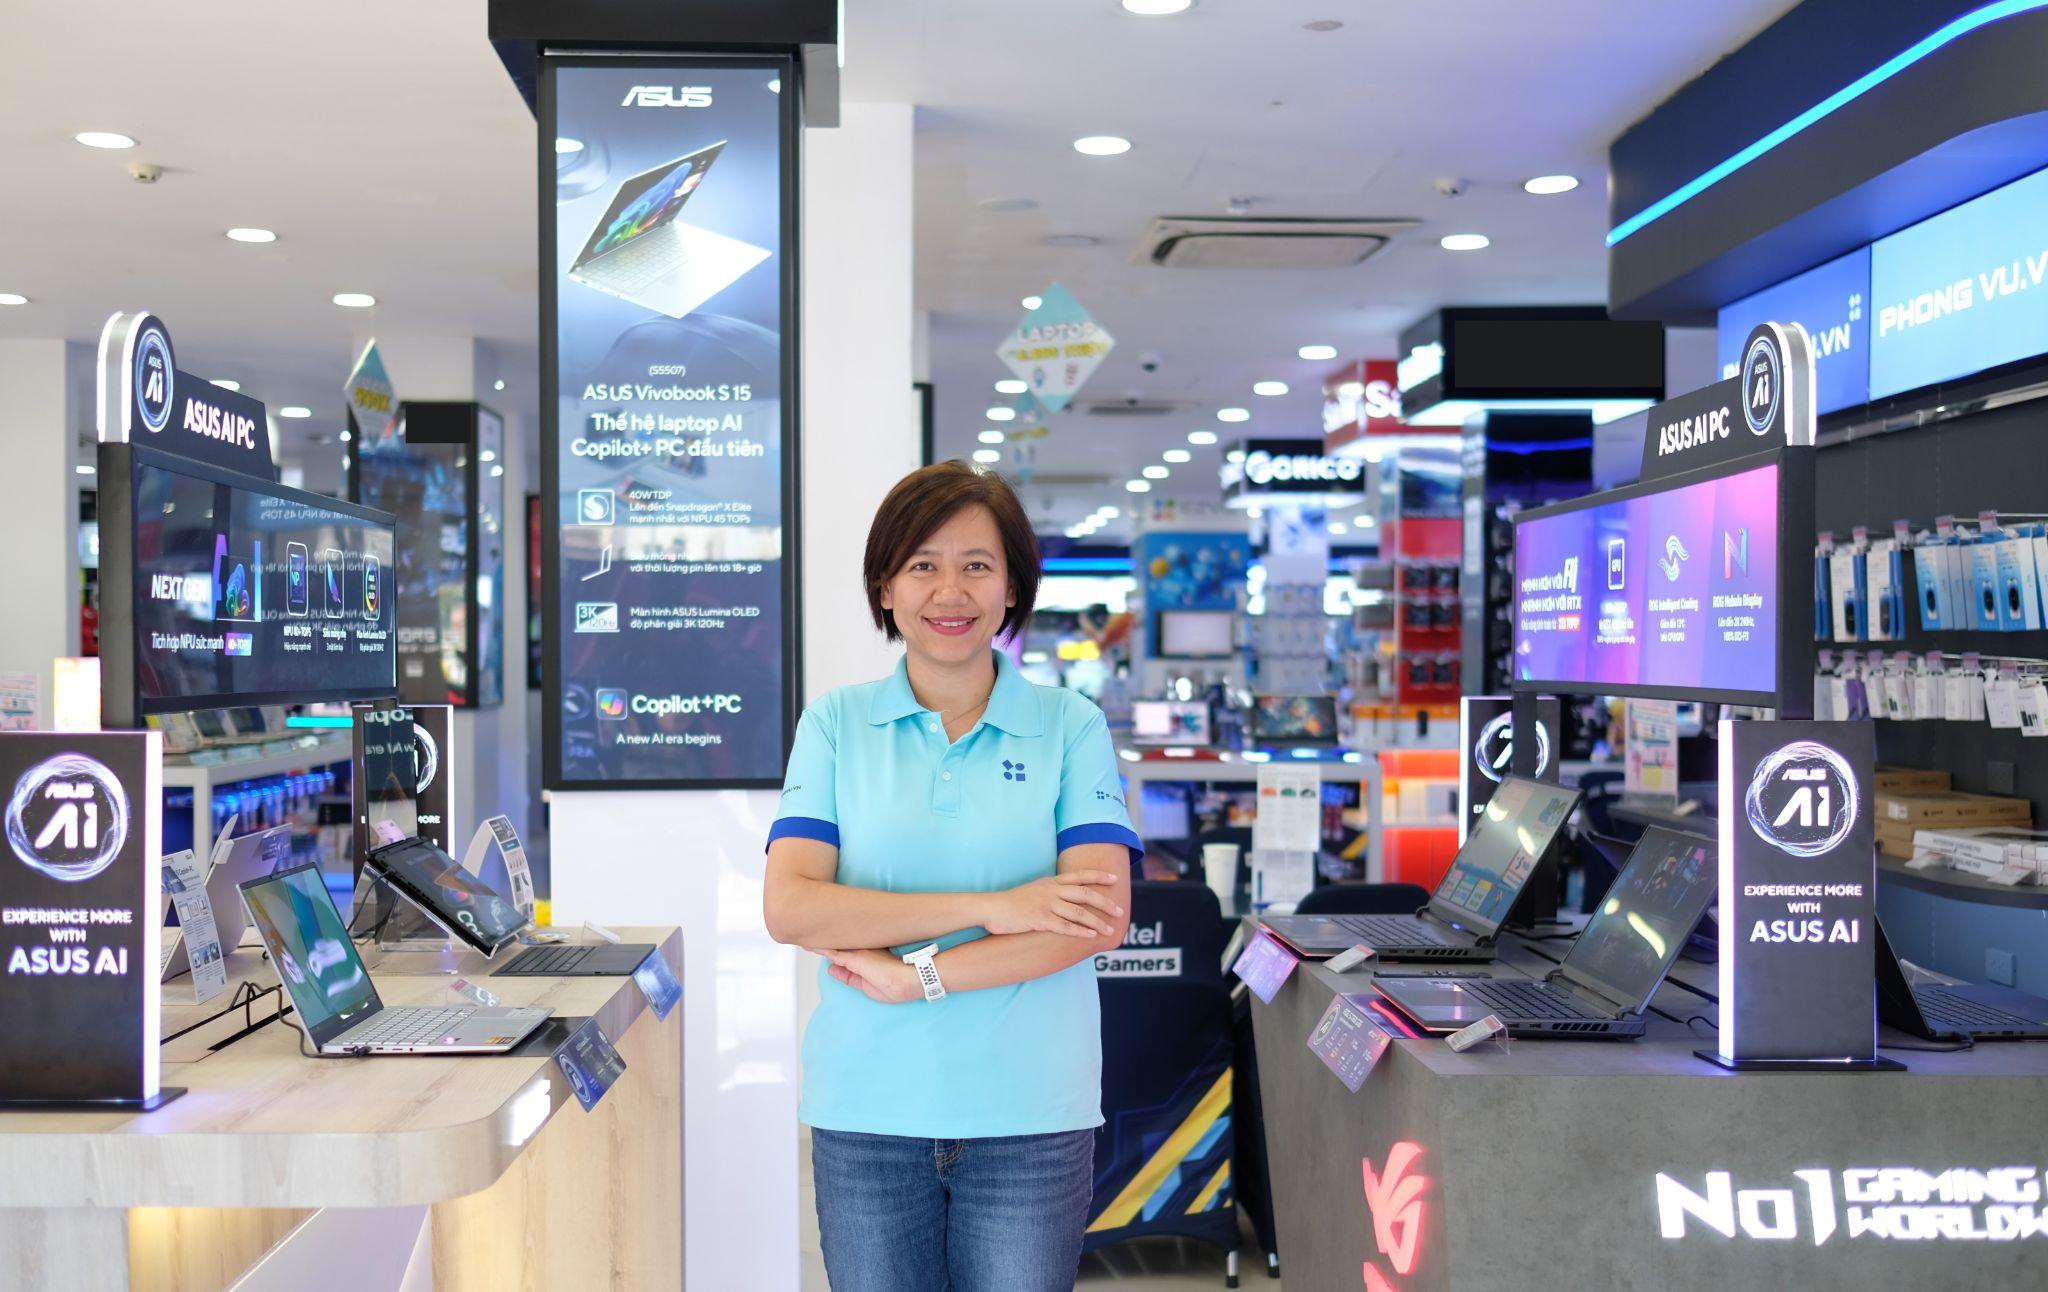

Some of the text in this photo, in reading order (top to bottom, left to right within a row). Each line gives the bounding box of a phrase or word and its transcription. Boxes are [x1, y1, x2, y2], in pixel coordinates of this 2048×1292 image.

[621, 86, 712, 107] ASUS
[1880, 277, 1972, 336] PHONG
[1754, 361, 1767, 376] ASUS
[583, 384, 752, 401] ASUS Vivobook S 15
[183, 398, 255, 450] ASUS AI PC
[591, 411, 742, 436] Thế hệ laptop AI
[1658, 406, 1730, 456] ASUS AI PC
[571, 439, 651, 460] Copilot+
[655, 439, 684, 456] PC
[727, 439, 764, 456] tiên
[653, 490, 672, 500] TDP
[732, 503, 752, 512] Elite
[691, 515, 713, 523] NPU
[713, 515, 726, 523] 45
[151, 574, 183, 600] NEXT
[579, 607, 597, 618] 3K
[672, 608, 697, 617] ASUS
[732, 608, 760, 617] OLED
[684, 620, 696, 628] 3K
[180, 633, 196, 649] NPU
[616, 733, 722, 747] A new AI era begins
[1781, 768, 1827, 781] ASUS
[44, 782, 95, 799] ASUS
[1744, 884, 1863, 896] EXPERIENCE MORE
[2, 907, 133, 925] EXPERIENCE MORE
[1787, 902, 1821, 914] WITH
[49, 927, 87, 943] WITH
[1749, 919, 1860, 943] ASUS AI
[8, 946, 128, 975] ASUS AI
[1094, 955, 1175, 972] Gamers
[1843, 1166, 2040, 1203] GAMING
